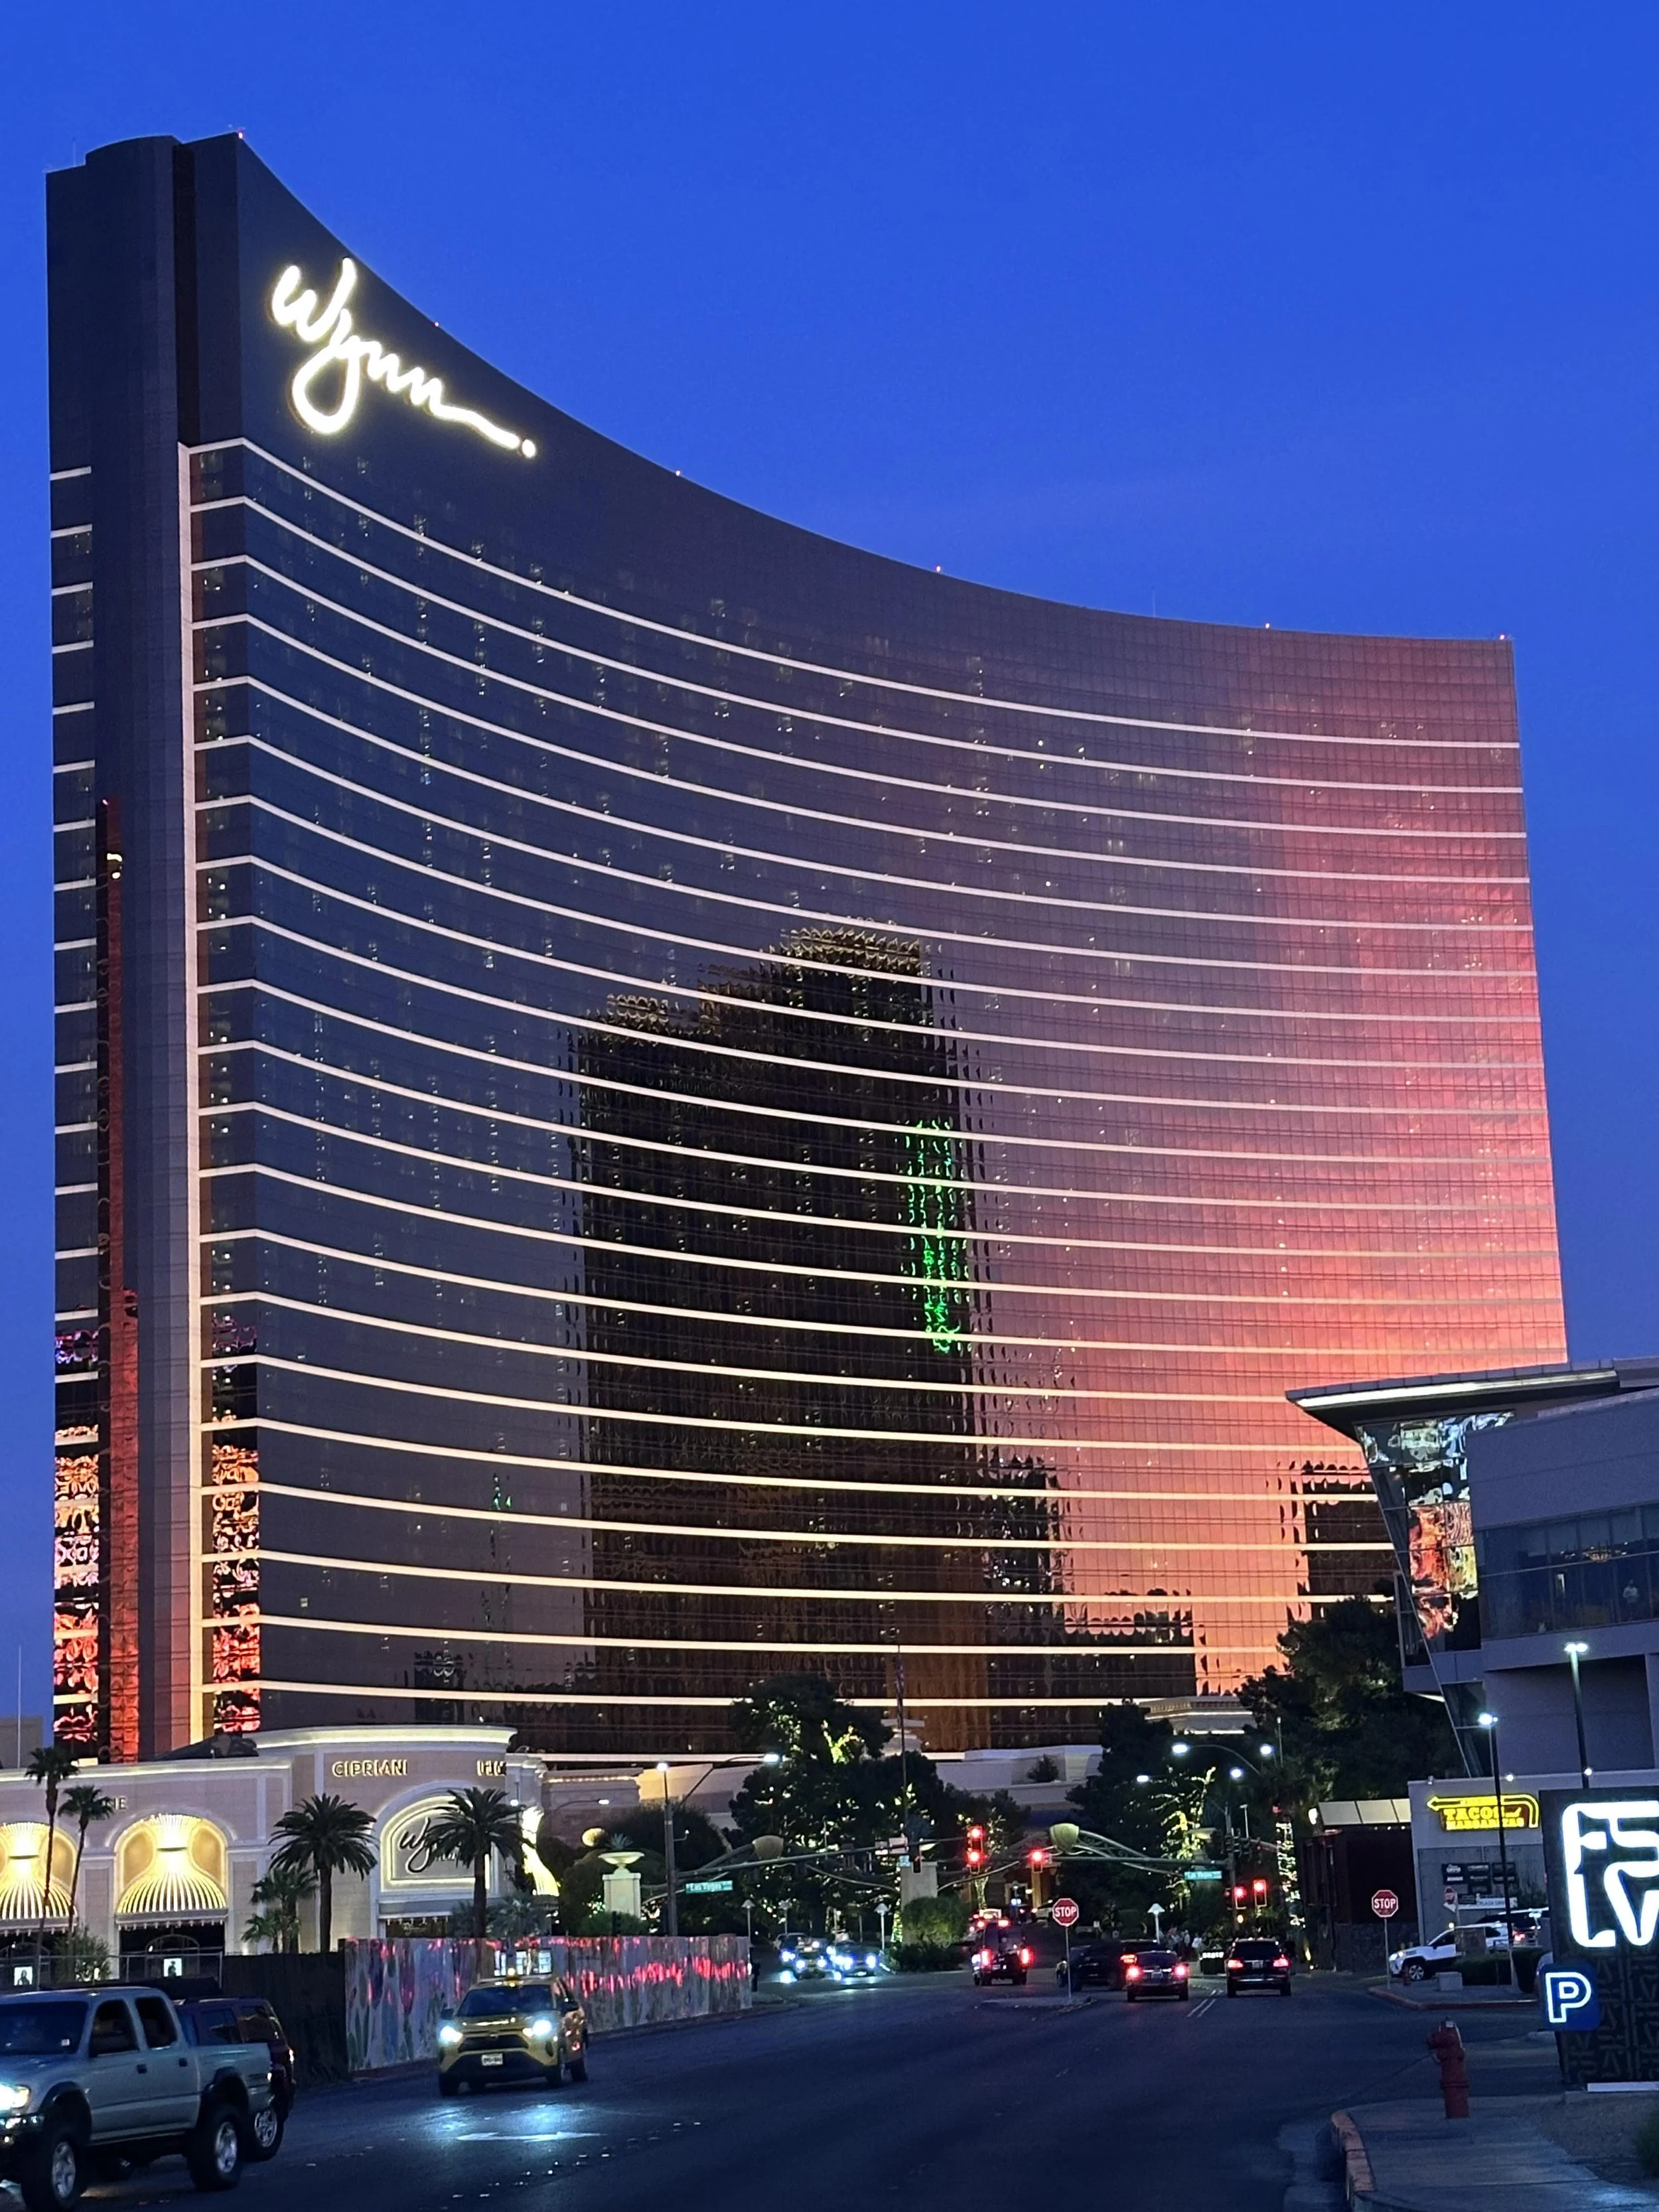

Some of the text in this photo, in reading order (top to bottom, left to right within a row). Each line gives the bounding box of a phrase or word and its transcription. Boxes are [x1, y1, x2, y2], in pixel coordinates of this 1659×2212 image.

[332, 1759, 408, 1777] CIPRIANI
[701, 1881, 722, 1893] Vegas
[1374, 1898, 1396, 1909] STOP
[1055, 1906, 1076, 1917] STOP
[1545, 1972, 1591, 2023] P
